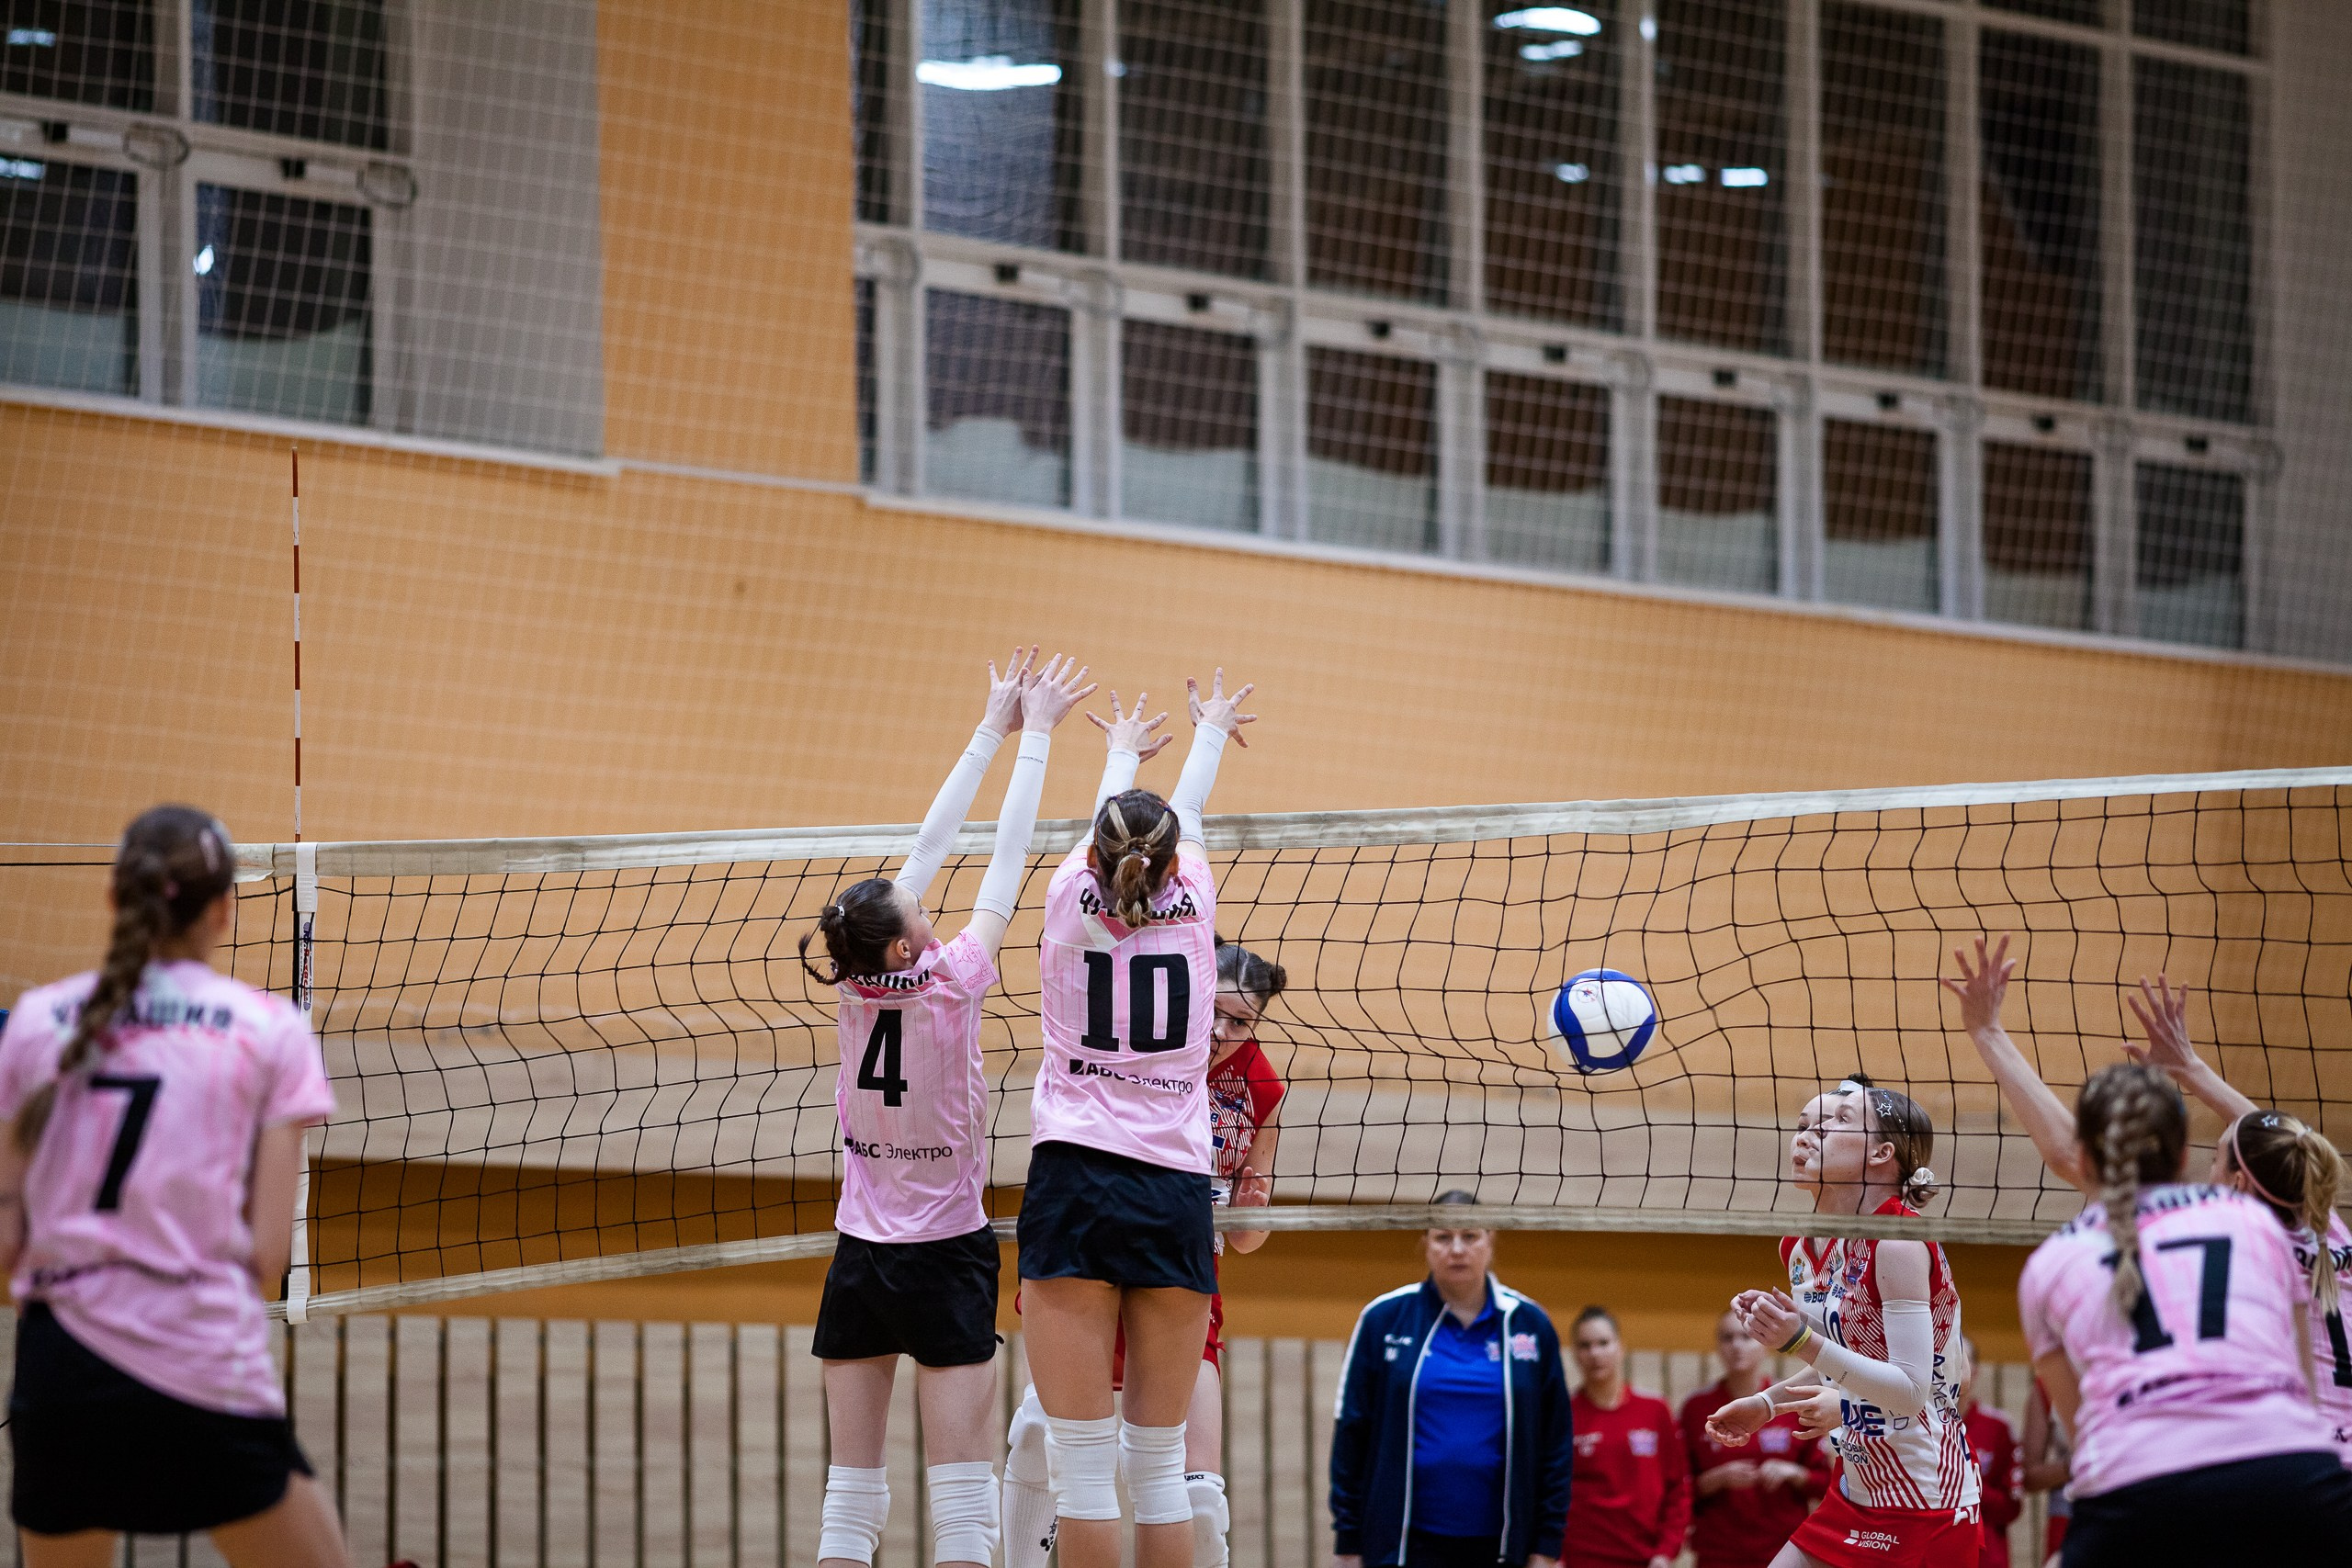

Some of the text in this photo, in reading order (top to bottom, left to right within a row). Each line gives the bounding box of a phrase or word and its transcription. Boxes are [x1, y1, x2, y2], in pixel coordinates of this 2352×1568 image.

[1080, 950, 1189, 1054] 10
[857, 1009, 909, 1108] 4
[1128, 1074, 1193, 1096] Электро
[89, 1074, 164, 1211] 7
[854, 1141, 953, 1162] АБС Электро
[2100, 1235, 2232, 1354] 17
[1858, 1540, 1891, 1551] VISION
[1861, 1531, 1900, 1545] GLOBAL
